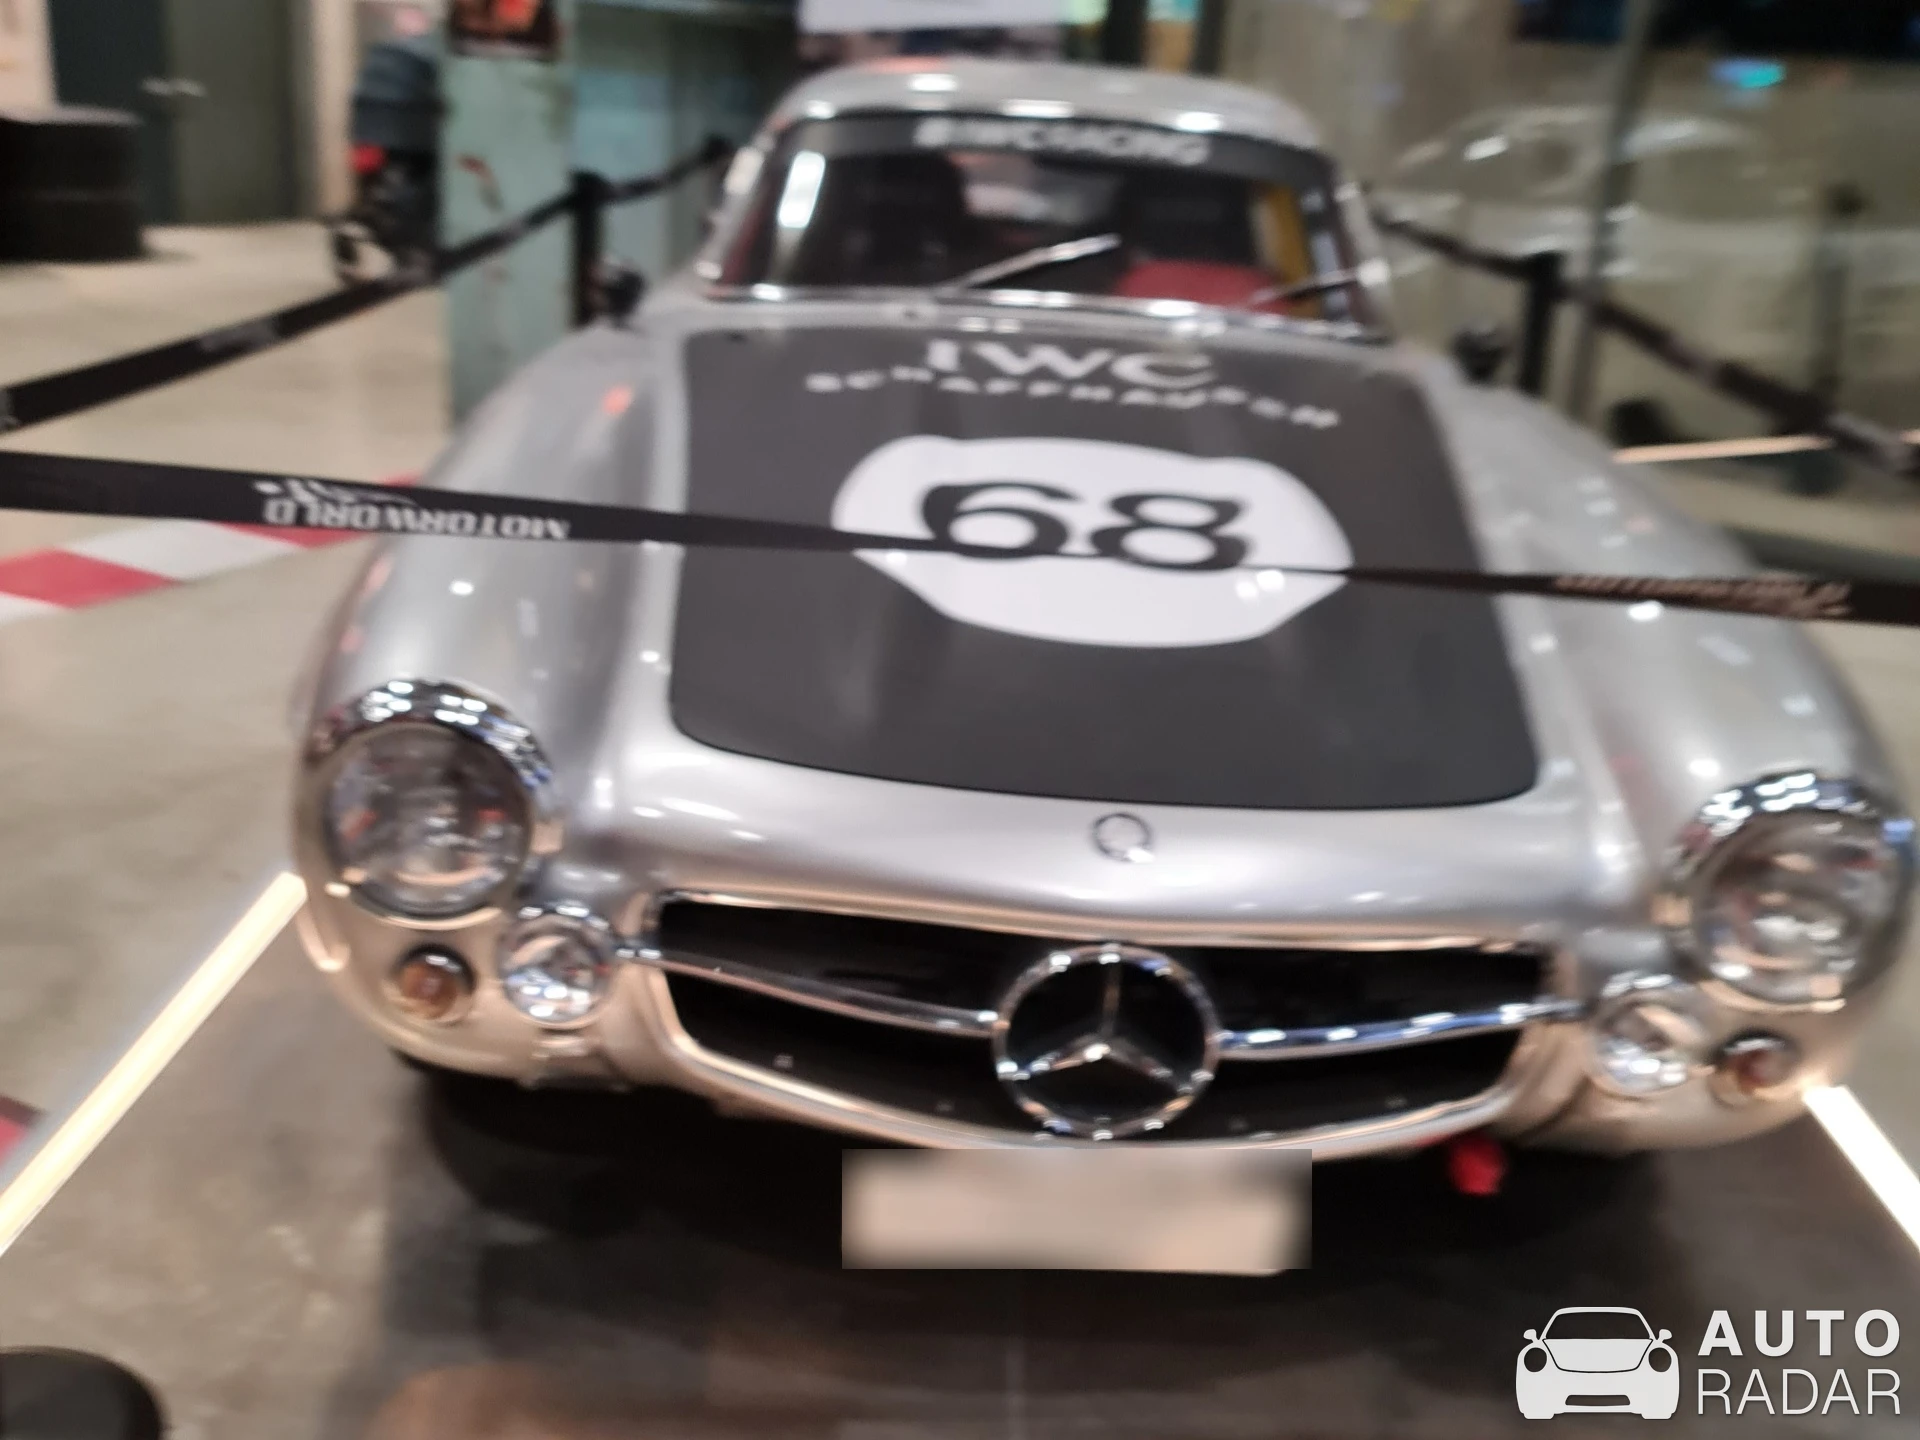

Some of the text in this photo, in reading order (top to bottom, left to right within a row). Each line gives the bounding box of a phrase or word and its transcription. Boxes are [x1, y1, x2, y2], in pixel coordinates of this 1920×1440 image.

[926, 340, 1216, 389] IWC
[804, 366, 1340, 429] SCHAFFHAUSEN
[263, 498, 571, 541] MOTORWORLD
[922, 482, 1249, 572] 68
